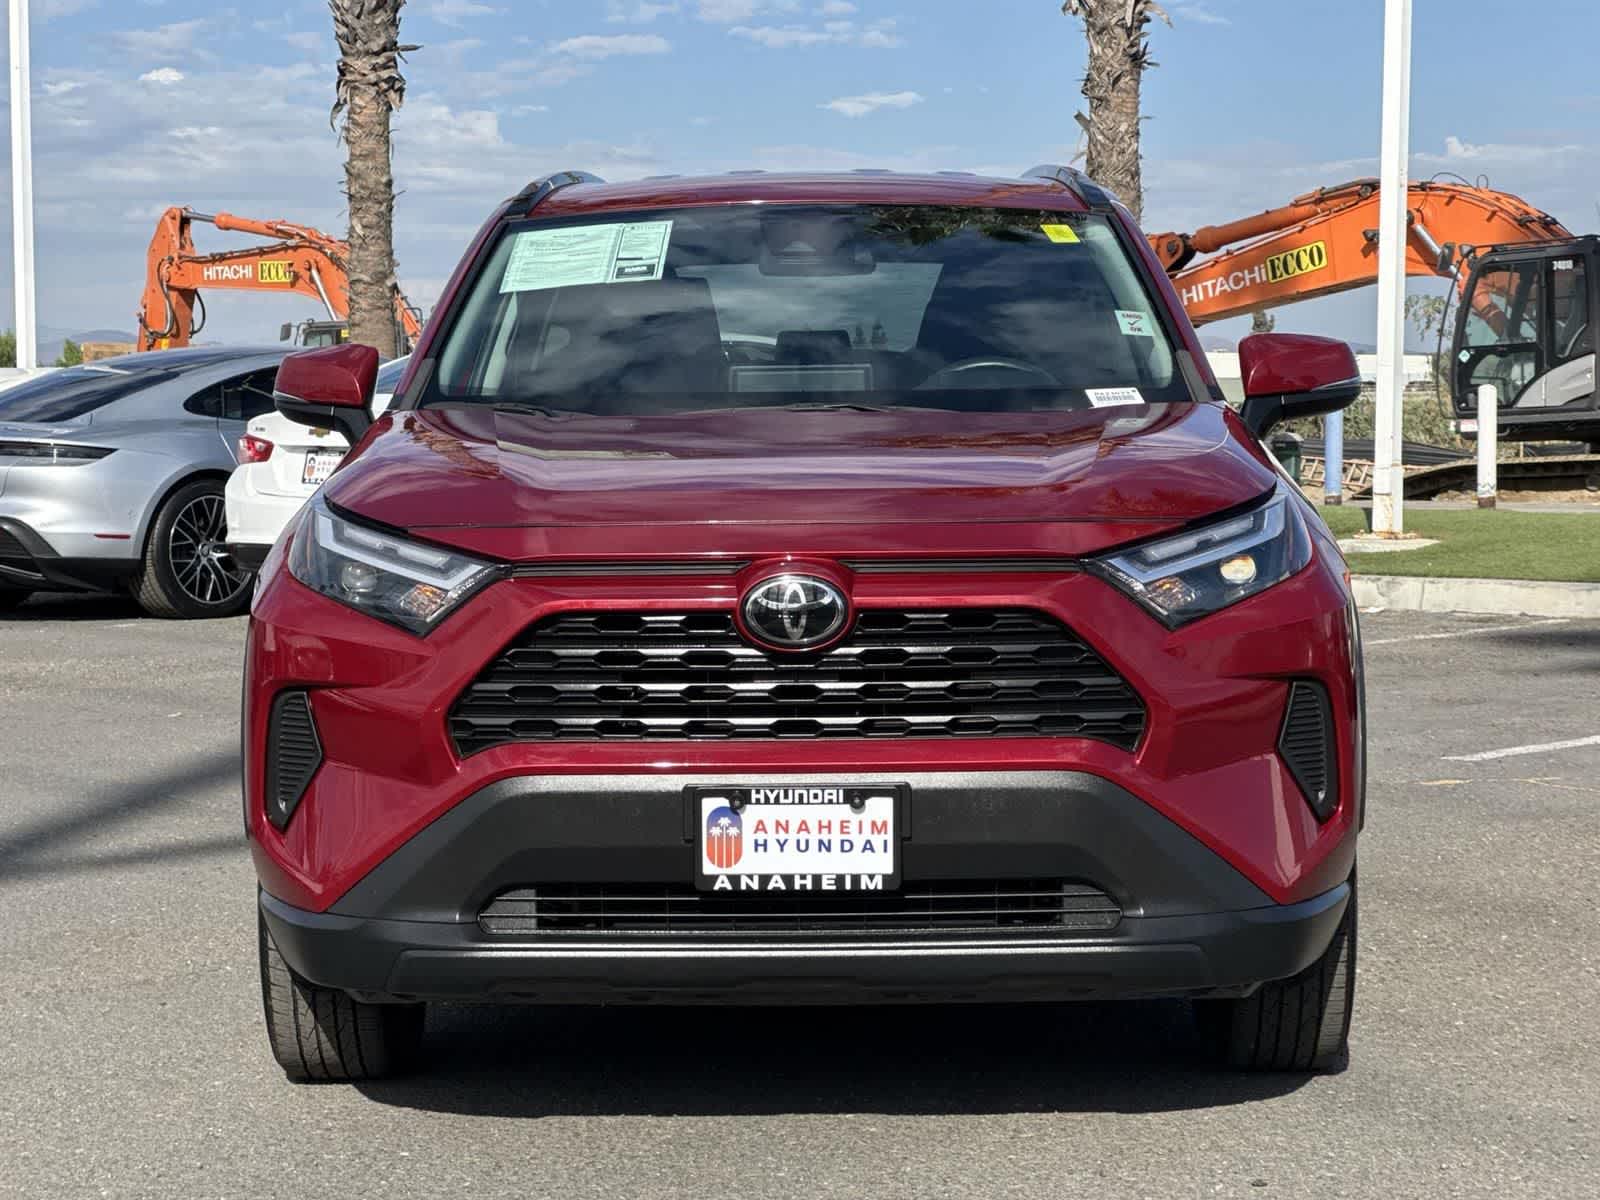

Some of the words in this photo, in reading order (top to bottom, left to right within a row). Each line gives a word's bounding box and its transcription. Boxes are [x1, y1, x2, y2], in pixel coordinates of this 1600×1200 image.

[203, 264, 253, 280] HITACHI
[1181, 264, 1267, 306] HITACHI
[1269, 244, 1324, 281] ECCO
[751, 788, 844, 804] HYUNDAI
[753, 819, 888, 835] ANAHEIM
[754, 838, 888, 853] HYUNDAI
[713, 874, 883, 890] ANAHEIM
